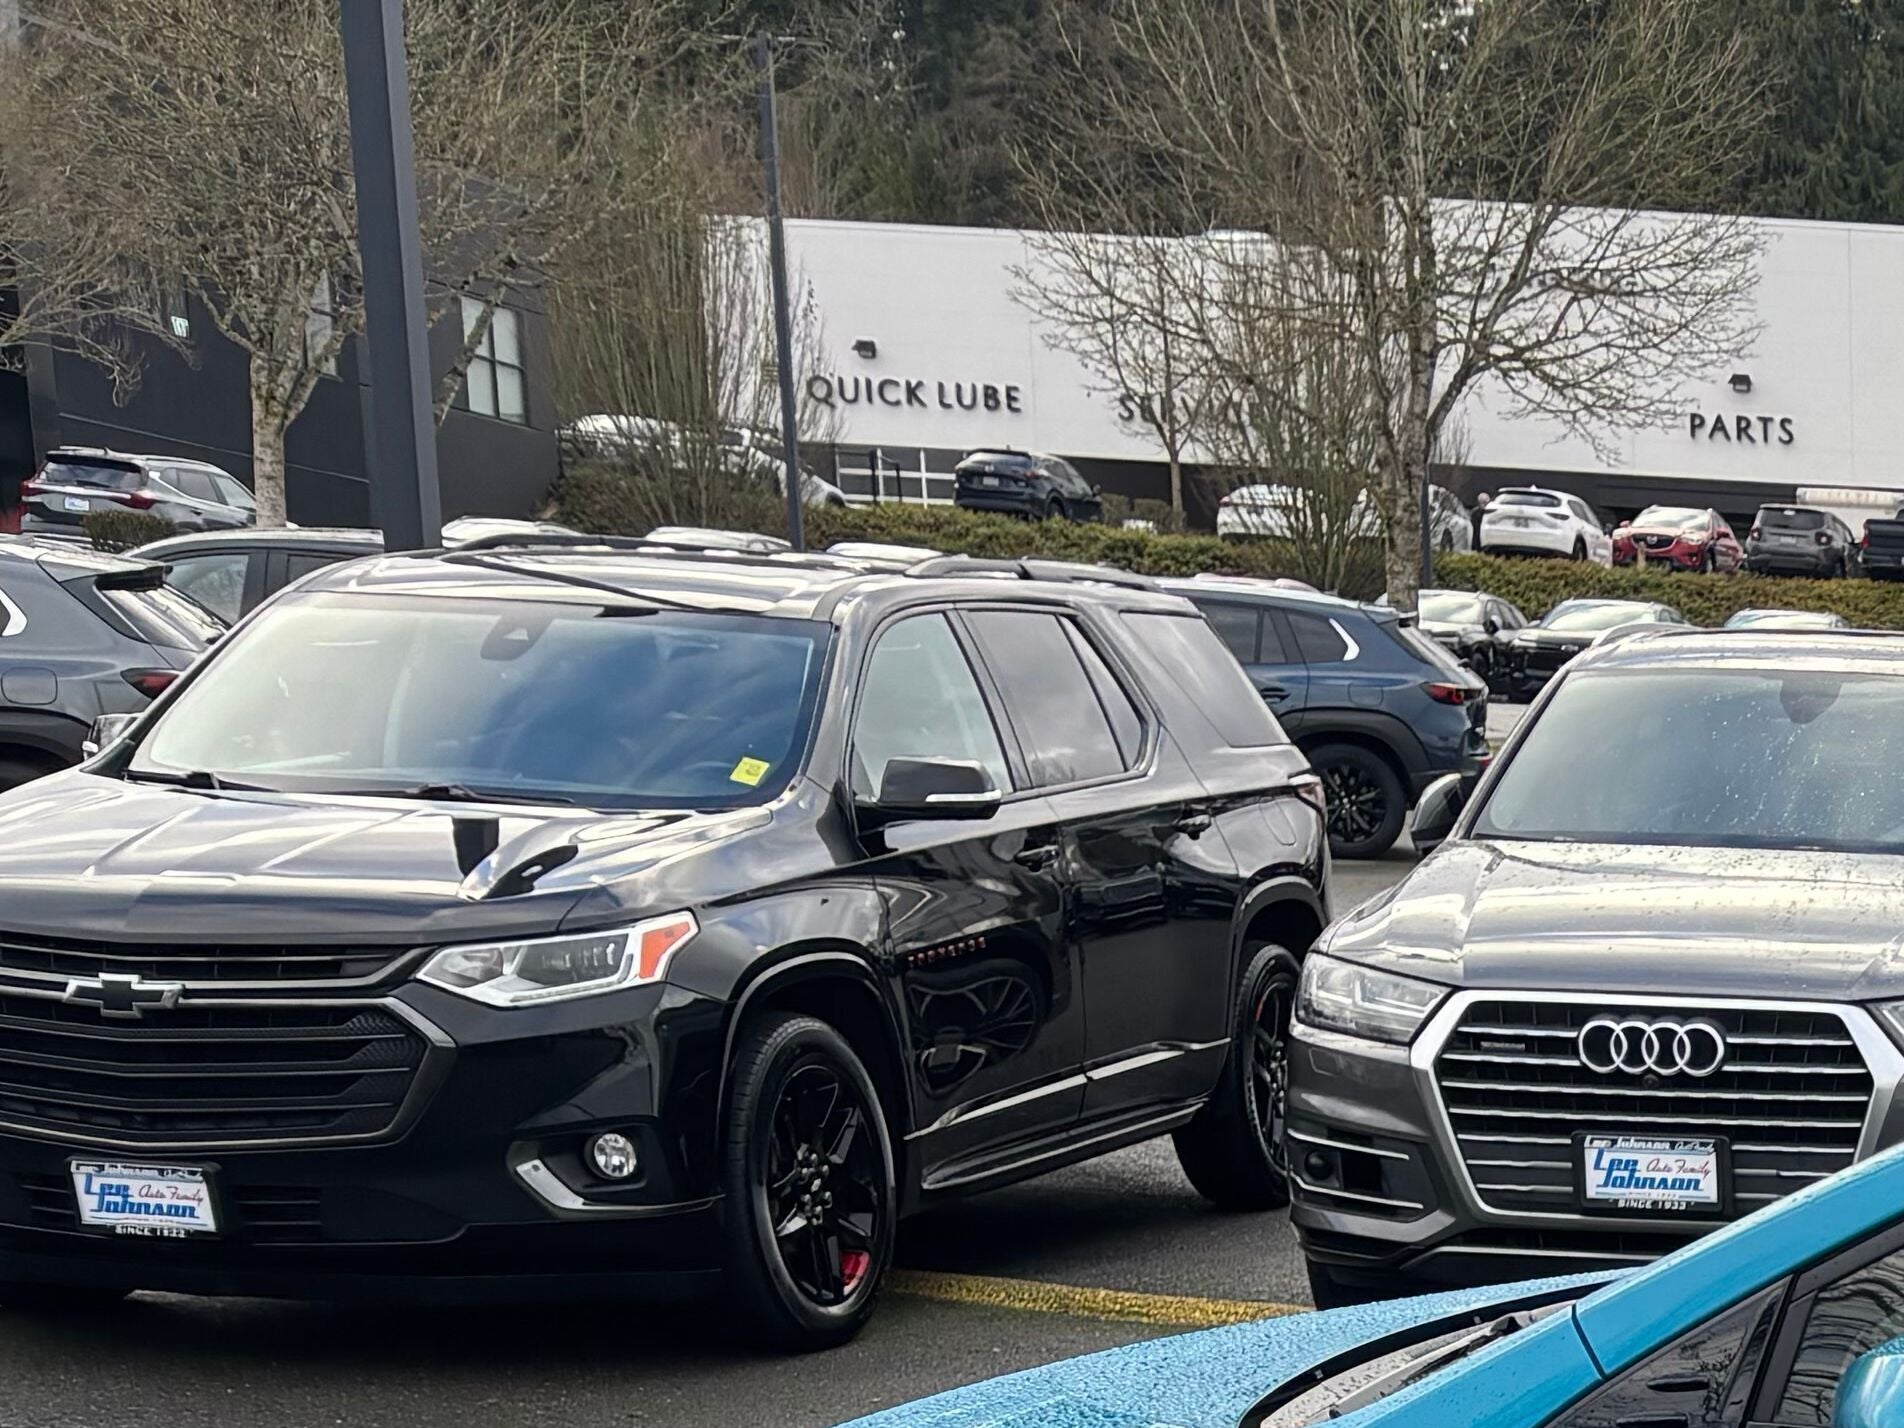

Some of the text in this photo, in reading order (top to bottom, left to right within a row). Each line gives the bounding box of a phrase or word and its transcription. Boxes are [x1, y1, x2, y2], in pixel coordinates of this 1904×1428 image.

[807, 375, 1022, 413] QUICK LUBE
[1690, 412, 1794, 445] PARTS
[1593, 1148, 1642, 1172] Lee
[1596, 1167, 1704, 1191] Johnson
[89, 1192, 200, 1219] Johnson
